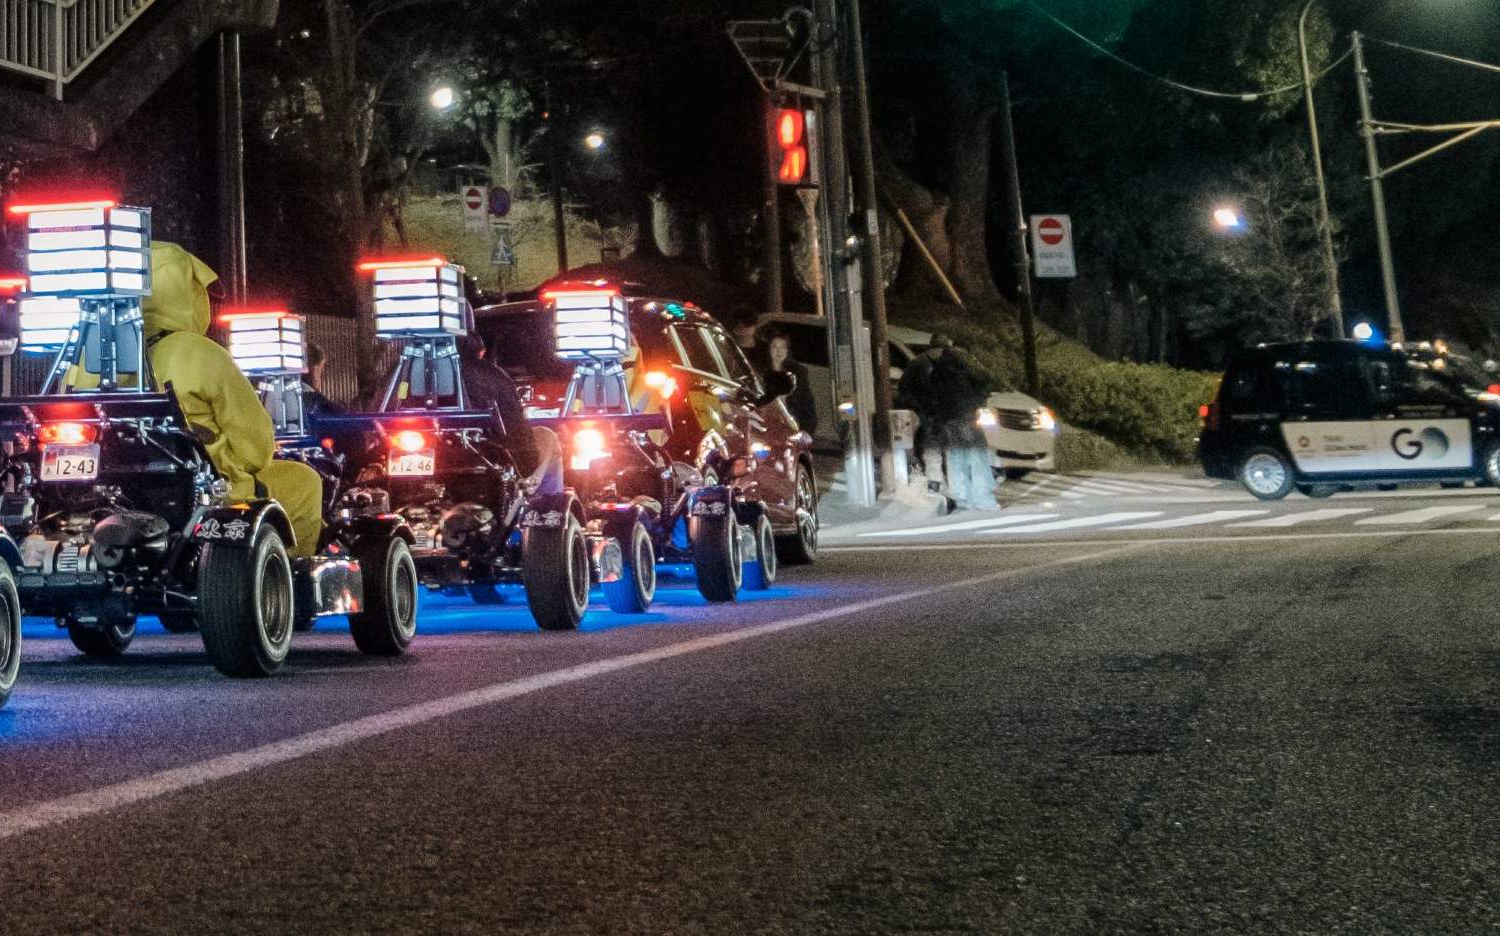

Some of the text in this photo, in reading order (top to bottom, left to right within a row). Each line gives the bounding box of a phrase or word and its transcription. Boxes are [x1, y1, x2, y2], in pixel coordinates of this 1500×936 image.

[56, 459, 95, 476] 12-43
[400, 459, 431, 472] 1246
[196, 518, 250, 540] 東京
